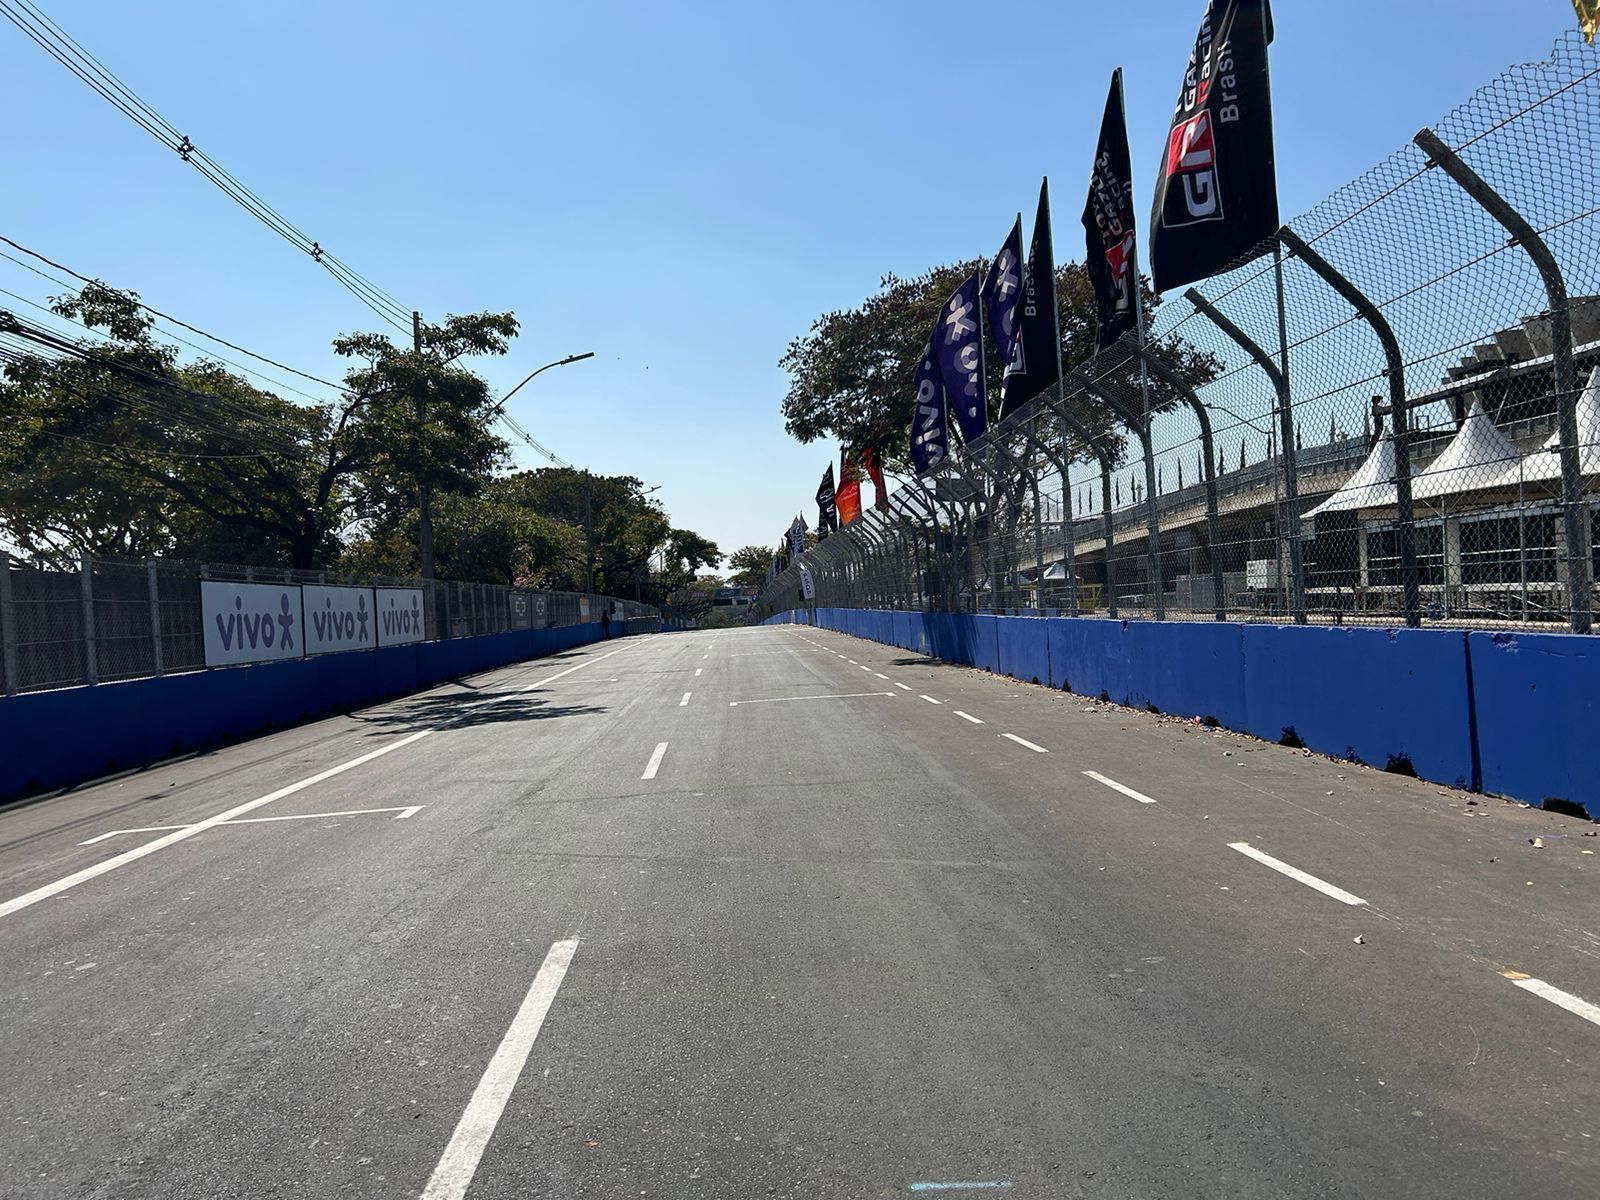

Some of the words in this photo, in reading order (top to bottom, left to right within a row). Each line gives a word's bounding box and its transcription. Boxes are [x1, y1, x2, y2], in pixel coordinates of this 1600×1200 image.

[1197, 0, 1214, 105] Racin
[916, 379, 944, 467] vivo
[215, 595, 275, 651] vivo
[312, 596, 355, 642] vivo
[382, 597, 411, 636] vivo
